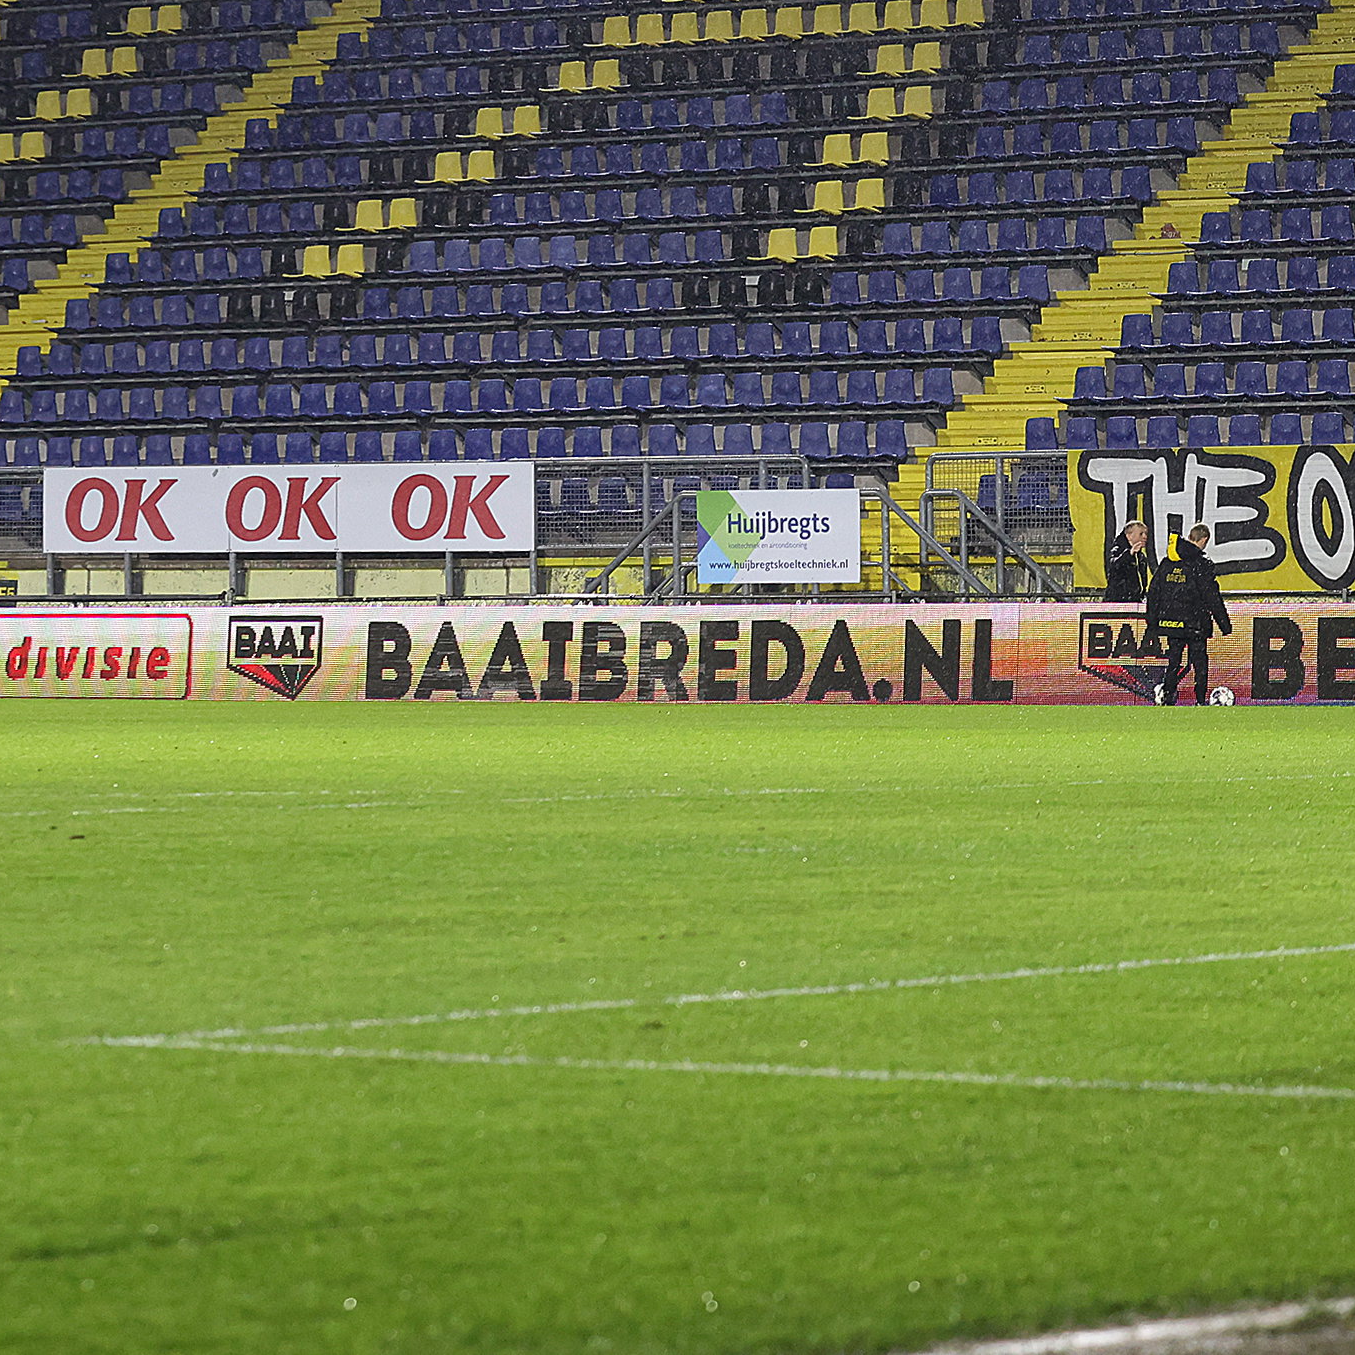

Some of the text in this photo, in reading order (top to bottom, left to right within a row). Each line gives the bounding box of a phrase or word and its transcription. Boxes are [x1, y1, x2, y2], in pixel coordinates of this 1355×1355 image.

[65, 474, 509, 543] OK OK OK
[728, 511, 830, 540] Huijbregts
[1083, 451, 1280, 569] THE
[709, 559, 849, 571] www.huijbregtskoeltechniek.nl
[235, 624, 315, 659] BAAI
[1088, 623, 1166, 659] BAA
[1158, 620, 1184, 628] LEGEA
[6, 636, 170, 680] divisie
[365, 619, 1014, 702] BAAIBREDA.NL
